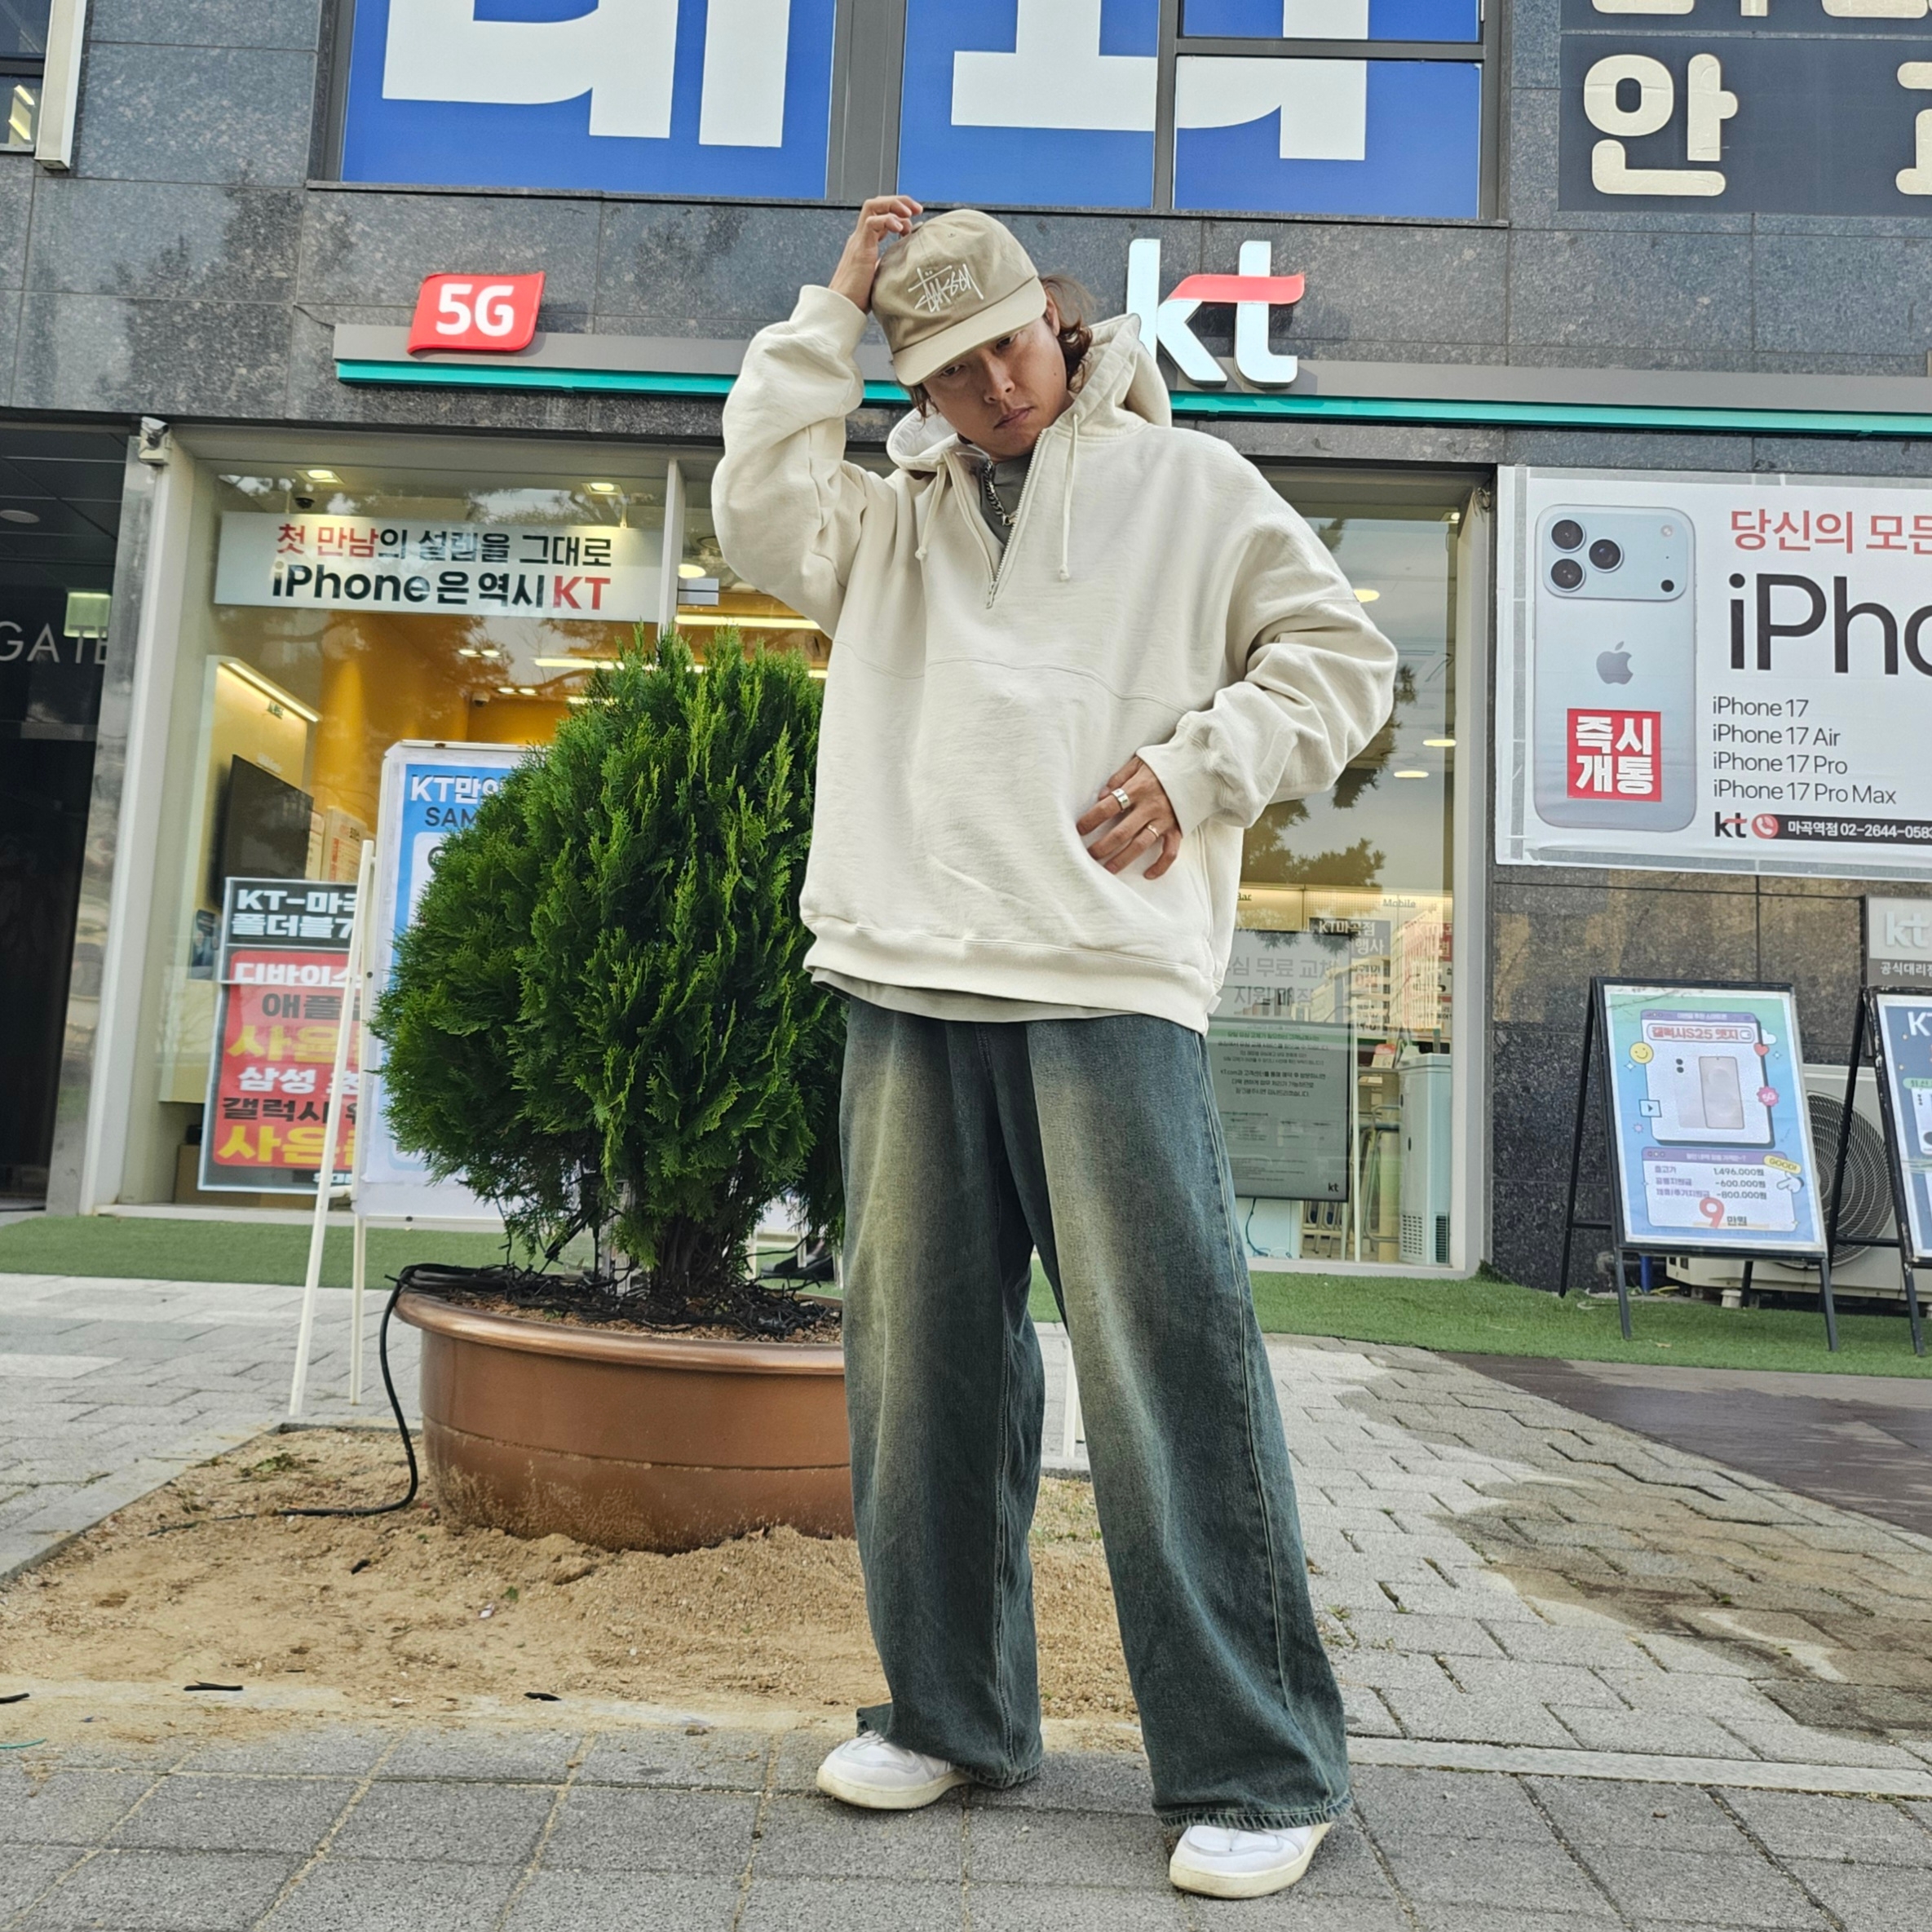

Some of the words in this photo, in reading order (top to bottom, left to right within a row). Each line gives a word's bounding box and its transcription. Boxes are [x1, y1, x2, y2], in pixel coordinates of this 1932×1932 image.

[1583, 53, 1739, 197] 안
[435, 283, 515, 337] 5G
[1125, 238, 1305, 387] kt
[276, 523, 307, 555] 첫
[317, 525, 408, 560] 만남의
[519, 534, 612, 568] 그대로
[1731, 509, 1853, 555] 당신의
[552, 575, 612, 612] KT
[1713, 696, 1783, 717] iPhone
[1784, 699, 1810, 718] 17
[1576, 716, 1652, 755] 즉시
[1713, 723, 1783, 745] iPhone
[1785, 727, 1810, 745] 17
[1812, 727, 1841, 747] Air
[1575, 754, 1654, 794] 개통
[1713, 751, 1784, 772] iPhone
[1785, 754, 1810, 773] 17
[1814, 755, 1849, 775] Pro
[1713, 779, 1784, 800] iPhone
[1786, 782, 1810, 801] 17
[1815, 783, 1849, 803] Pro
[1852, 785, 1897, 805] Max
[1714, 811, 1748, 838] kt
[1788, 820, 1838, 837] 마곡역점
[1886, 911, 1930, 948] kt
[1256, 958, 1294, 979] 무료
[238, 1067, 316, 1094] 삼성
[1328, 1183, 1339, 1192] kt
[1699, 1196, 1725, 1229] 9
